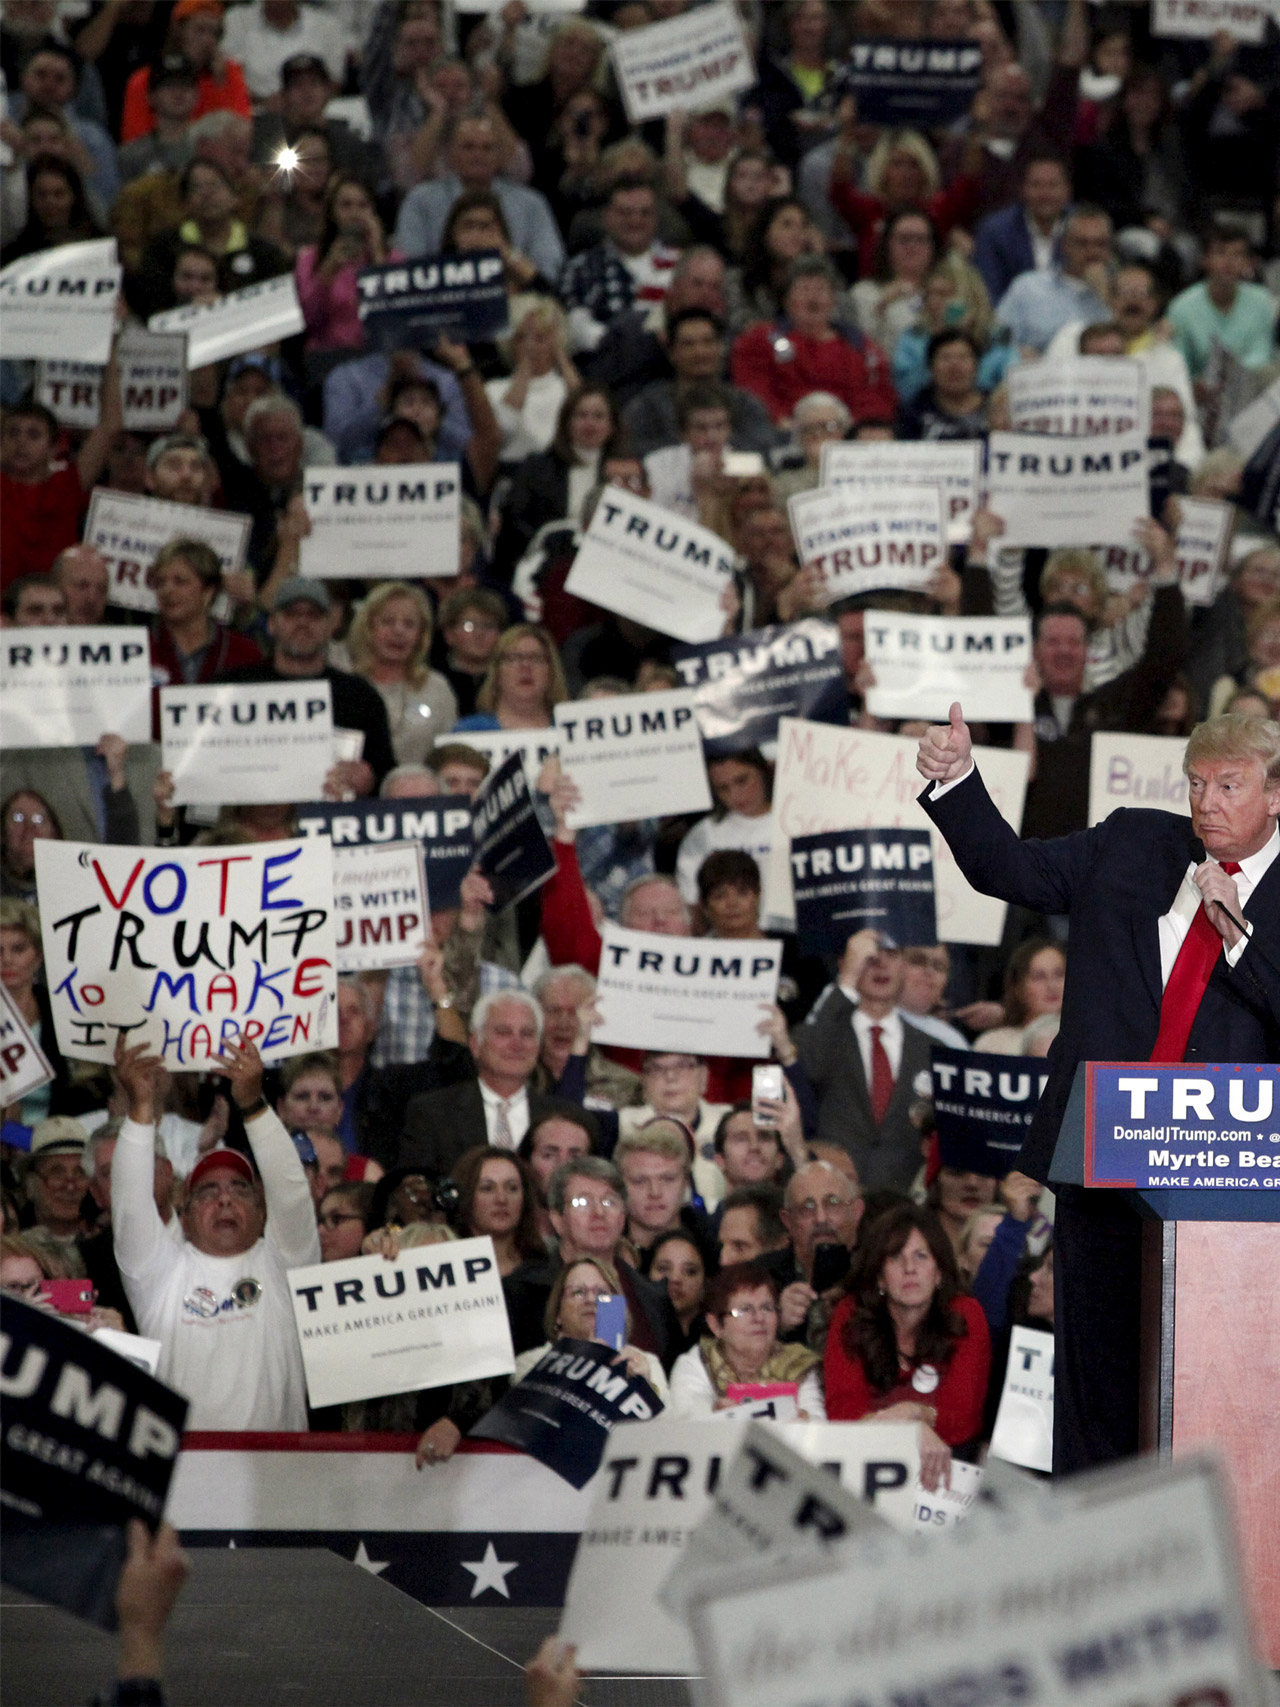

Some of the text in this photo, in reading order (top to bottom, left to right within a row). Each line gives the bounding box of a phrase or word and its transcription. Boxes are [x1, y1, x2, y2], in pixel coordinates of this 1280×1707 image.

[850, 44, 982, 72] TRUMP
[357, 257, 503, 298] TRUMP
[50, 382, 179, 408] TRMP
[996, 451, 1141, 476] TRUMP
[308, 481, 455, 506] TRUMP
[605, 503, 731, 574] TRUMP
[813, 541, 939, 582] TRUMP
[9, 643, 146, 668] RUMP
[869, 627, 1026, 653] TRUMP
[165, 699, 327, 727] TRUMP
[562, 708, 693, 743] TRUMP
[299, 809, 472, 844] TRUMP
[791, 842, 933, 879] TRUMP
[361, 889, 417, 908] WITH
[53, 904, 328, 972] TRUMP
[336, 913, 420, 947] UMP
[608, 945, 775, 979] TRUMP
[142, 957, 332, 1016] MAKE
[71, 1019, 148, 1046] IT
[932, 1062, 1049, 1102] TRU
[935, 1101, 1022, 1125] MAKE AMERICA
[1113, 1126, 1251, 1143] DonaldJTrump.com
[1148, 1150, 1230, 1170] Myrtle
[1148, 1176, 1190, 1187] MAKE
[1192, 1177, 1259, 1188] AMERICA
[296, 1257, 492, 1312] TRUMP
[302, 1295, 502, 1340] MAKE AMERICA GREAT AGAIN!
[0, 1331, 181, 1460] UMP
[536, 1351, 654, 1421] TRUMP
